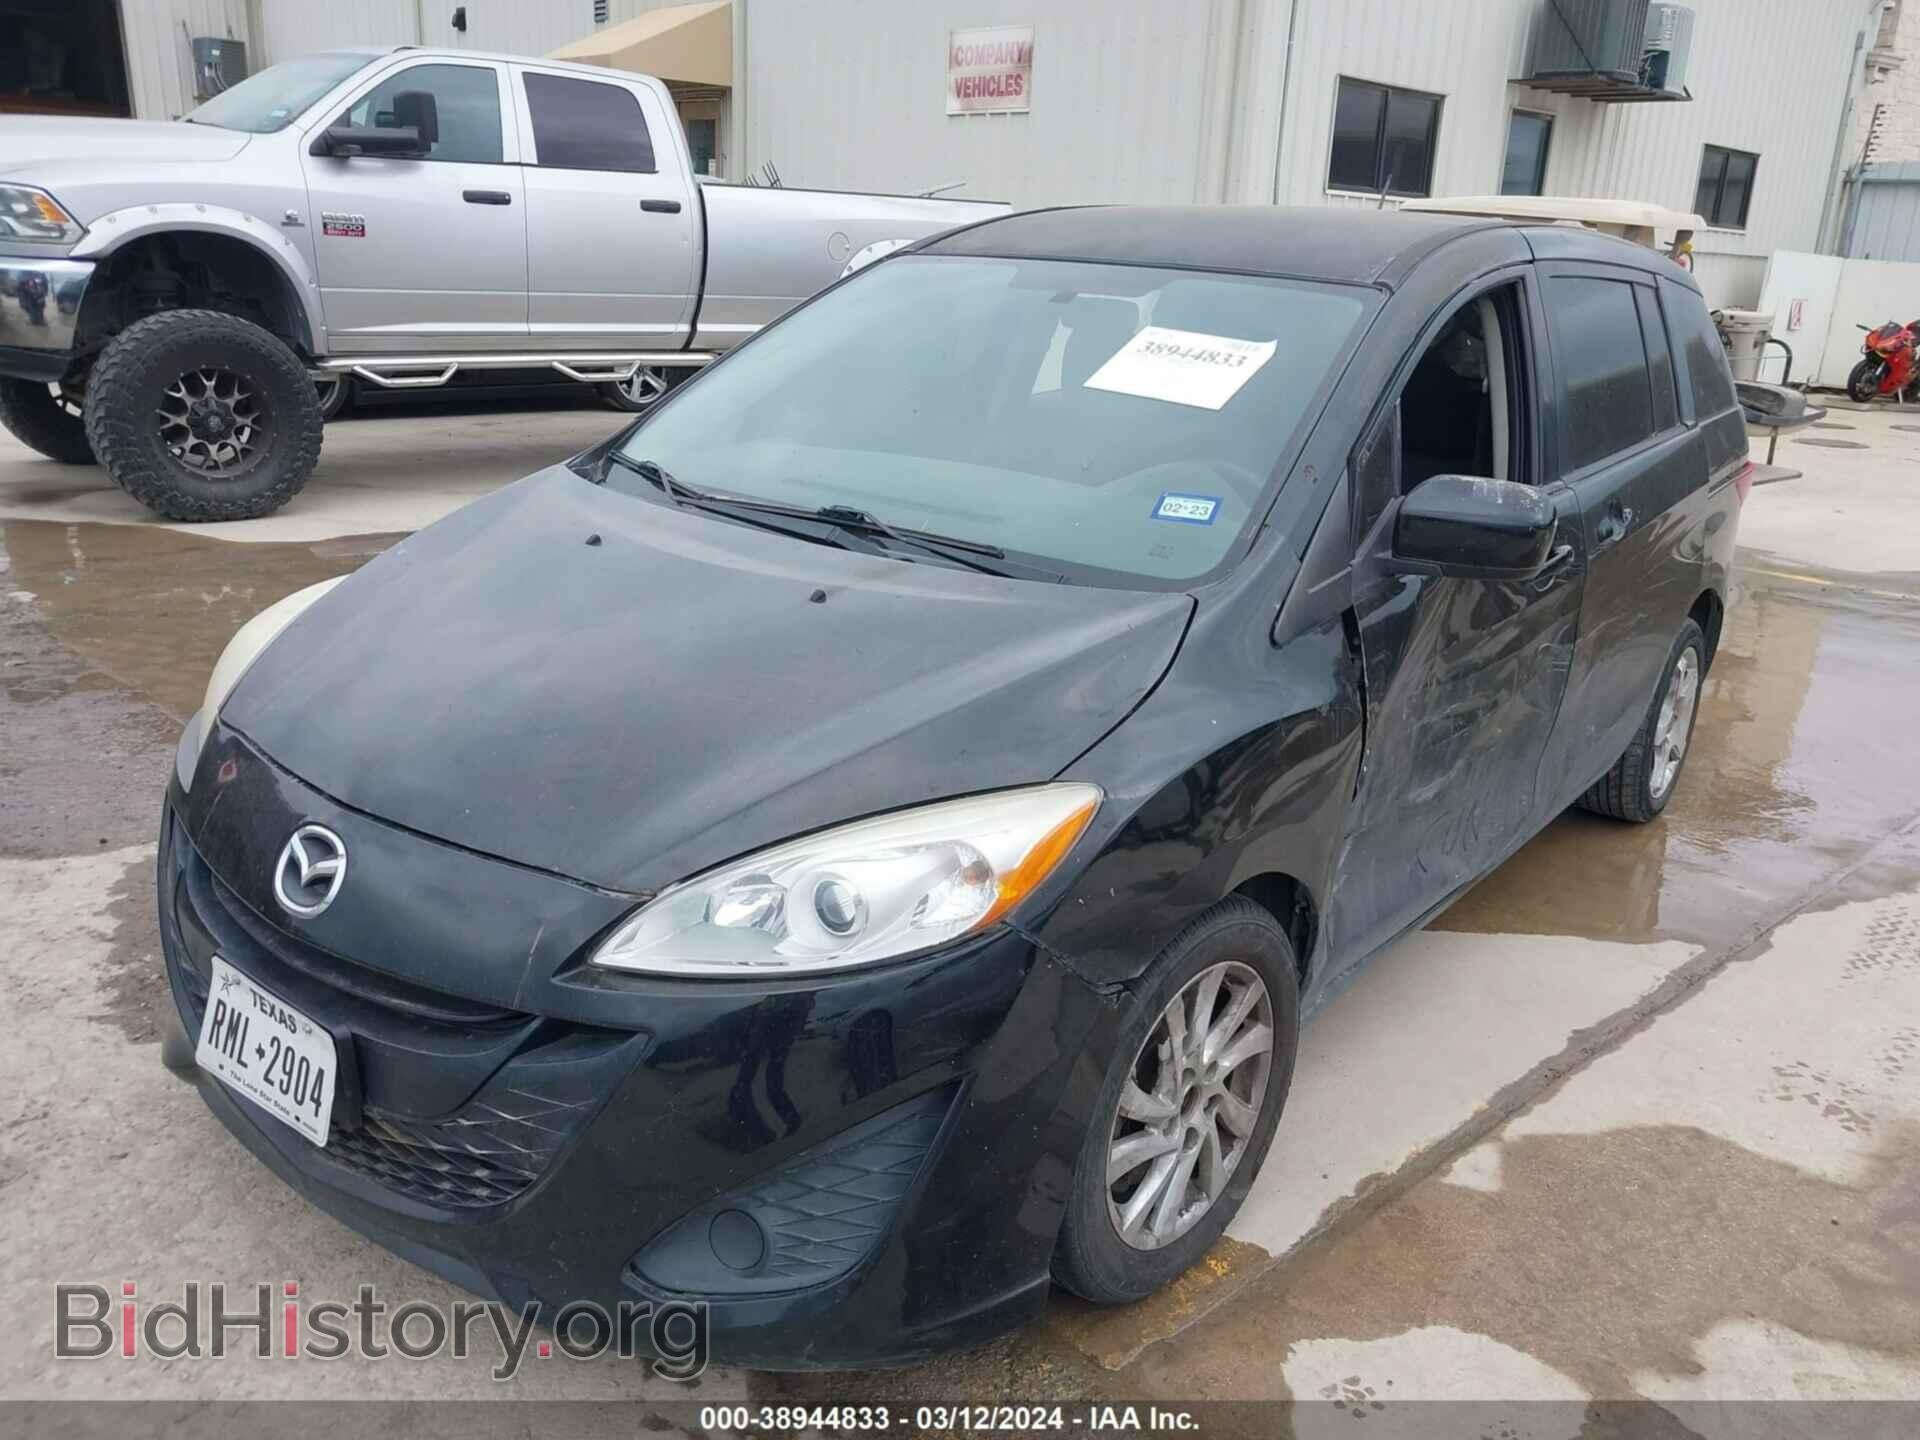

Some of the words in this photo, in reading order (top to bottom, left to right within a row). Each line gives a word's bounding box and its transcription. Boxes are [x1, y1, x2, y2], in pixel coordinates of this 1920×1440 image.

[954, 41, 1025, 66] COMPANY
[954, 73, 1024, 98] VEHICLES
[325, 222, 363, 231] 2500
[1136, 340, 1248, 367] 38944833
[250, 988, 297, 1035] TEXAS
[208, 998, 250, 1069] RML
[262, 1035, 325, 1118] 2904
